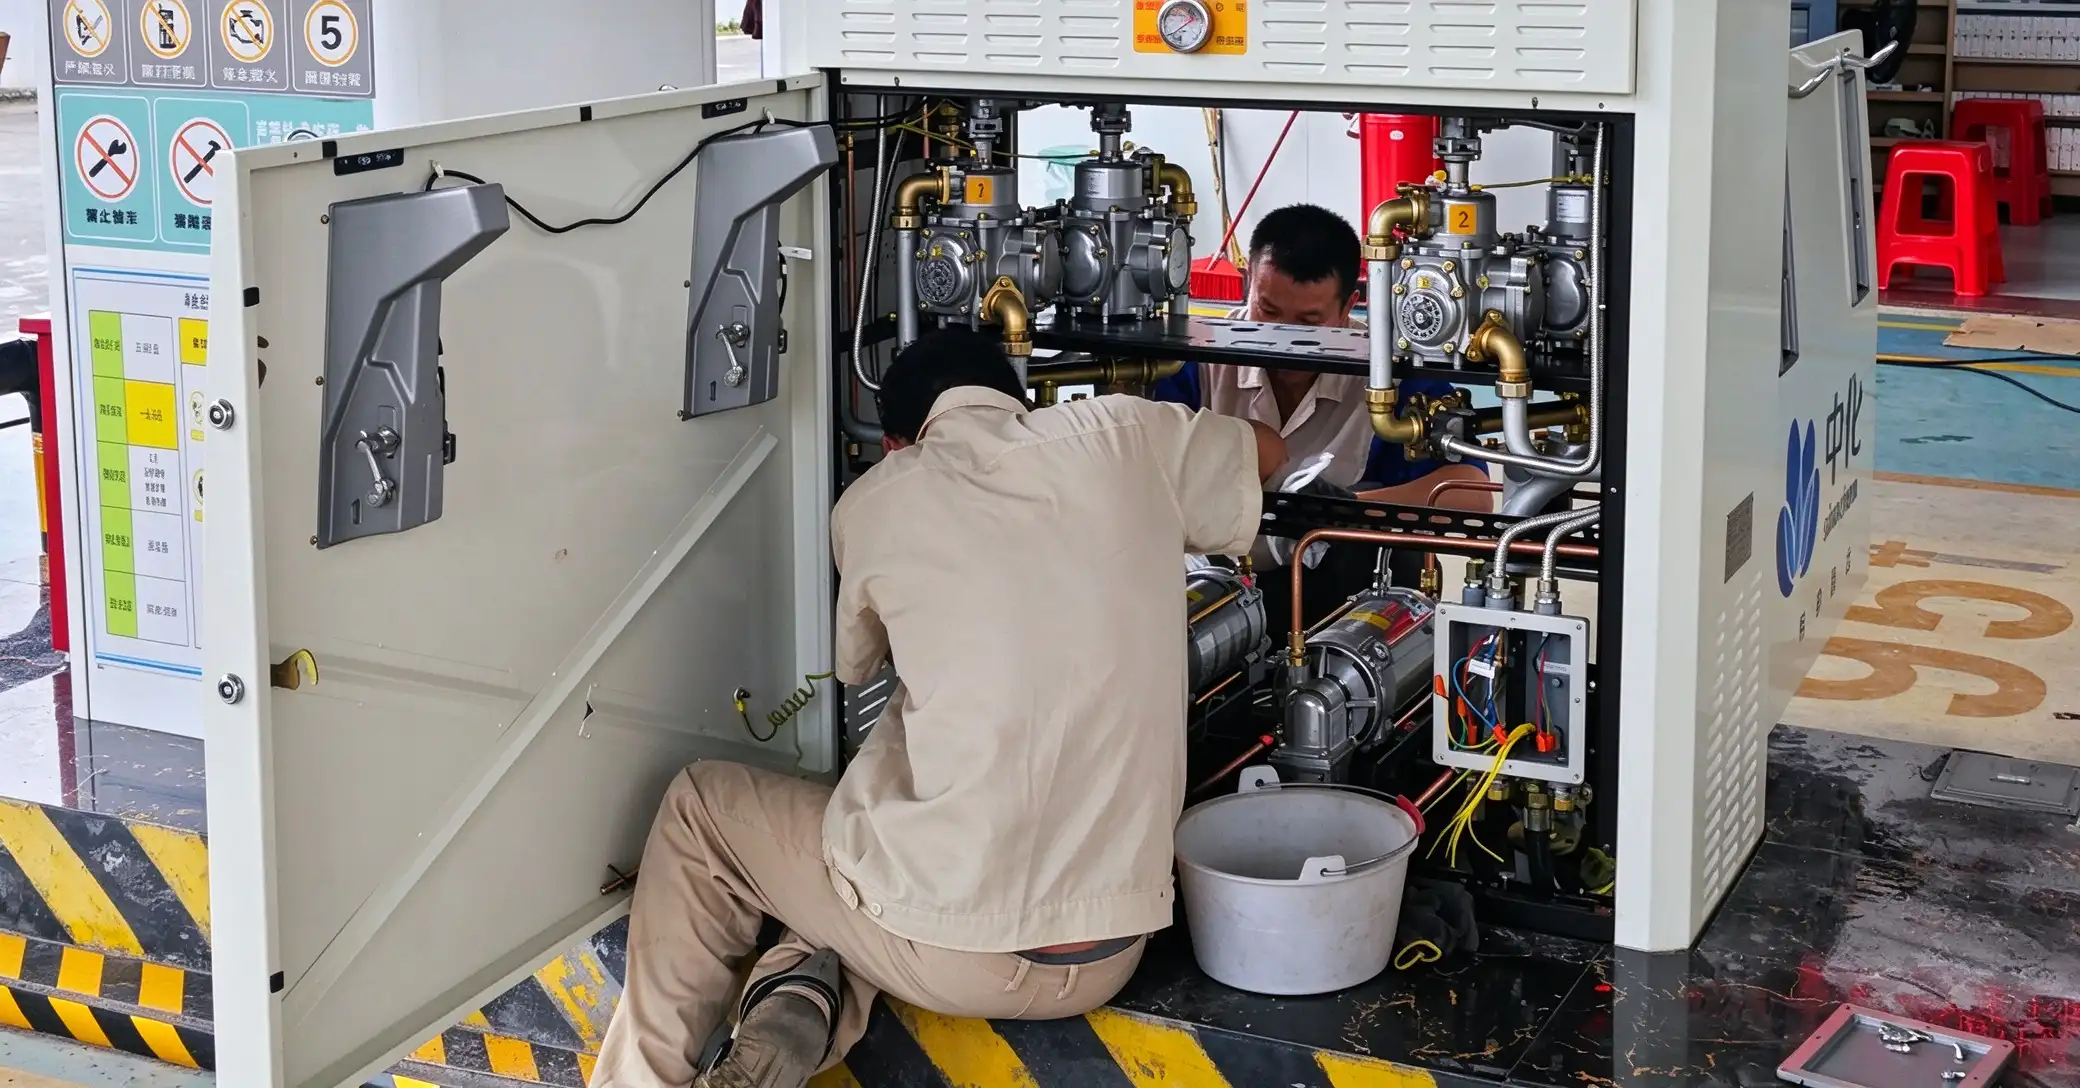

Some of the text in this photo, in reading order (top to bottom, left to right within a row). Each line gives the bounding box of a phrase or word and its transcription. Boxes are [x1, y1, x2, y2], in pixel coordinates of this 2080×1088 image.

[321, 15, 342, 50] 5
[1458, 210, 1470, 228] 2
[1825, 372, 1864, 486] 中化
